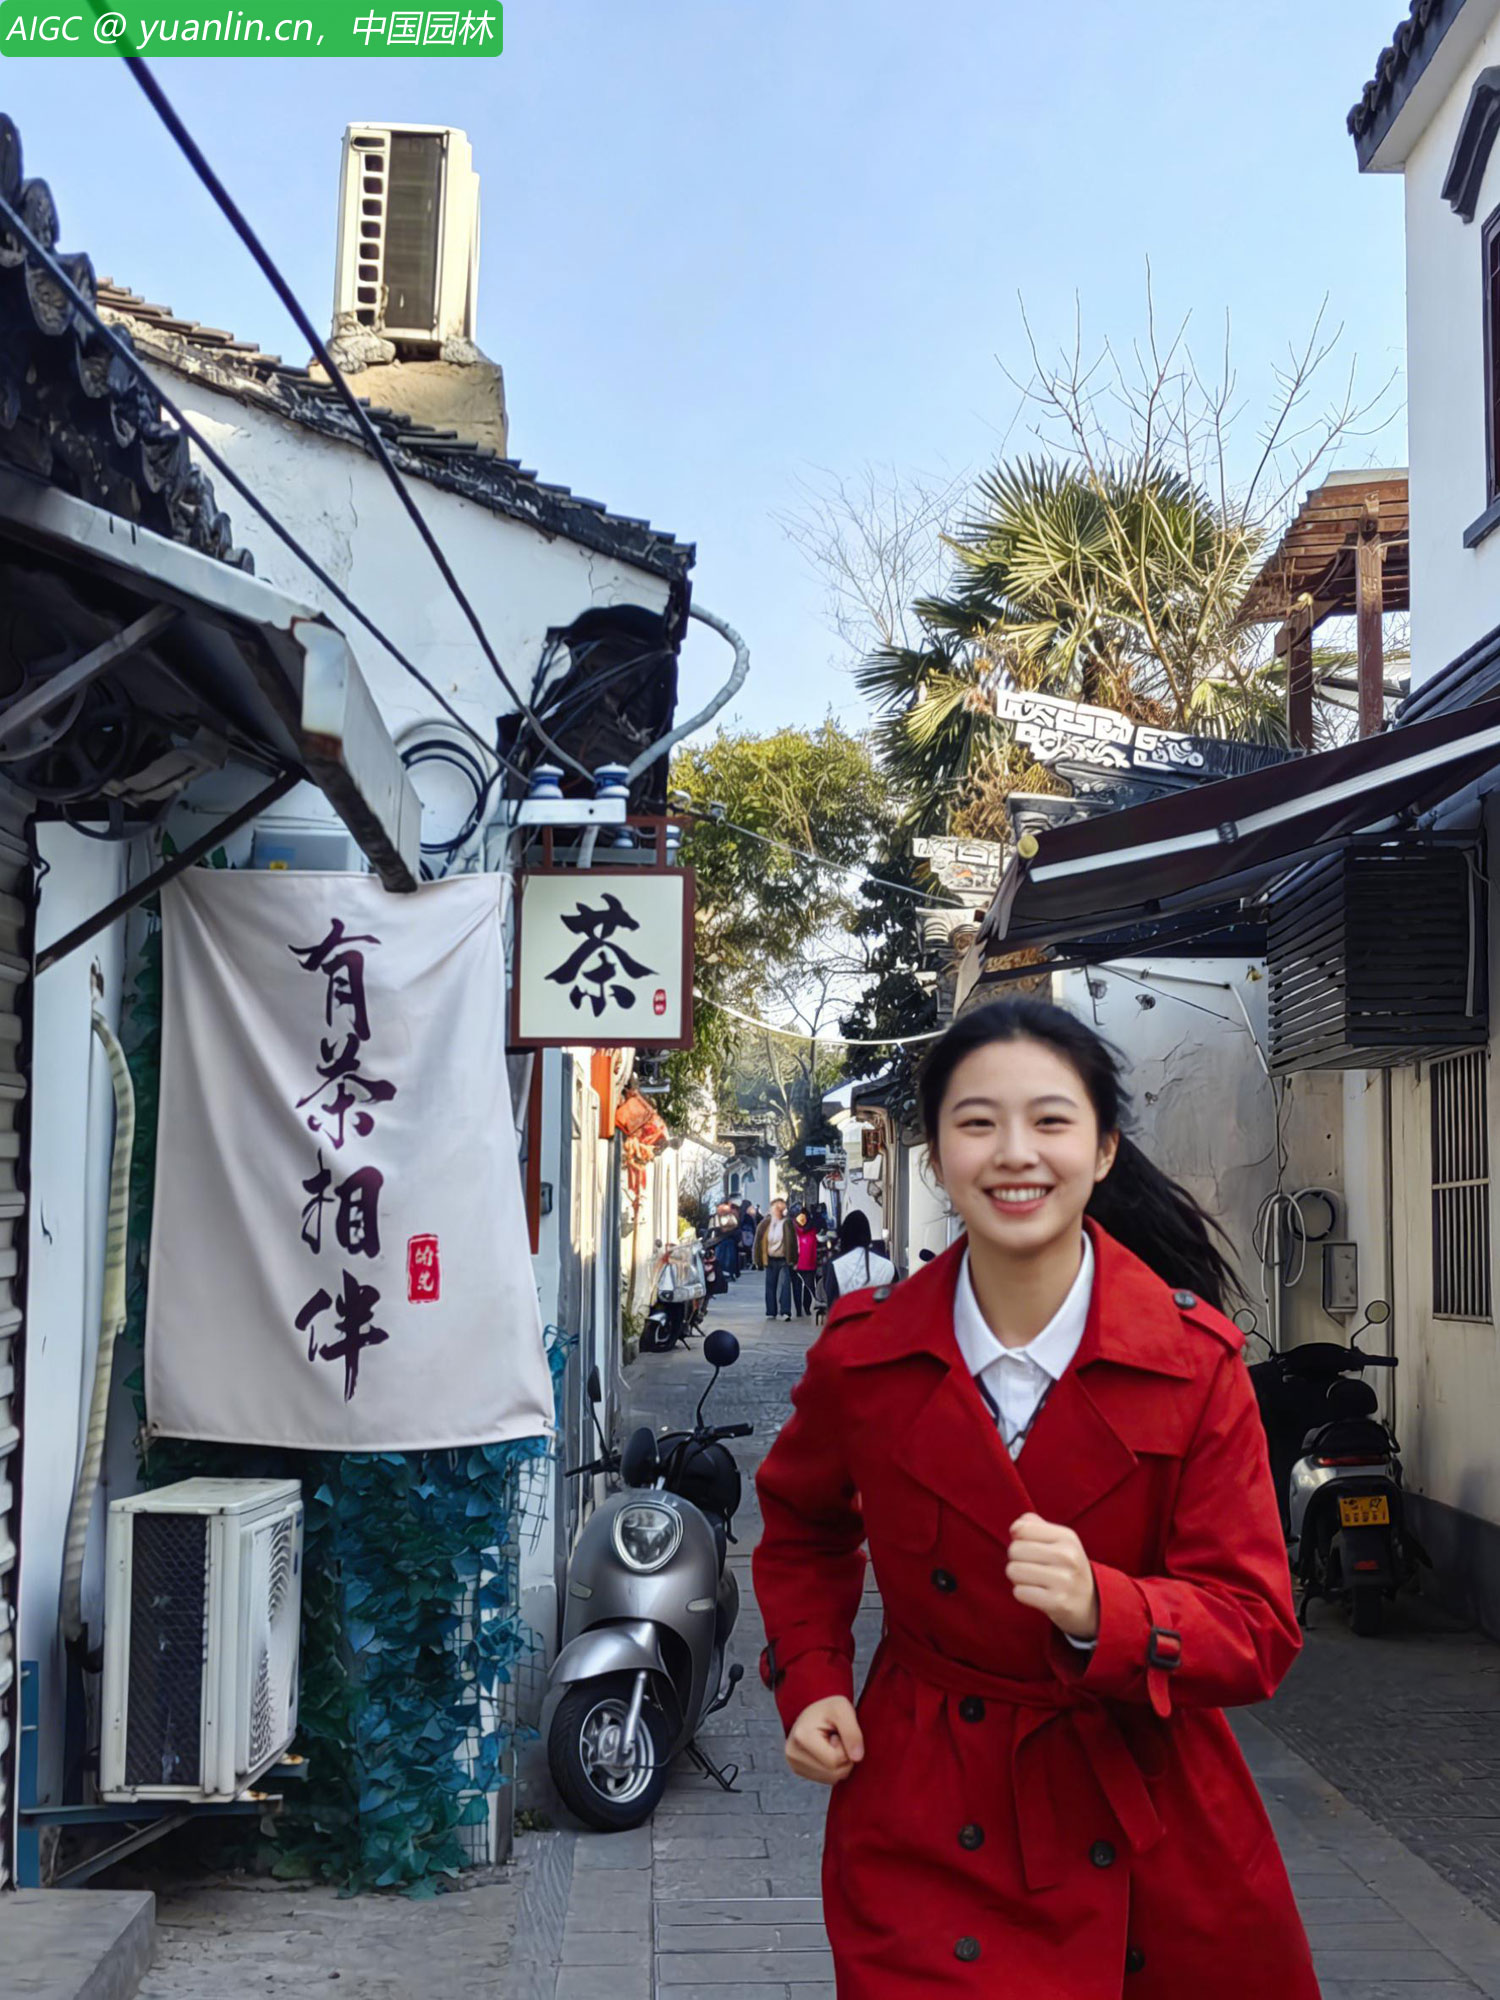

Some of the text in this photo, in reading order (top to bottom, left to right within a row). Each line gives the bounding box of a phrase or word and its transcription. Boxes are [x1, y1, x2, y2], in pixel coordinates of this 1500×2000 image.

[545, 893, 660, 1017] 茶
[288, 918, 397, 1402] 有茶相伴
